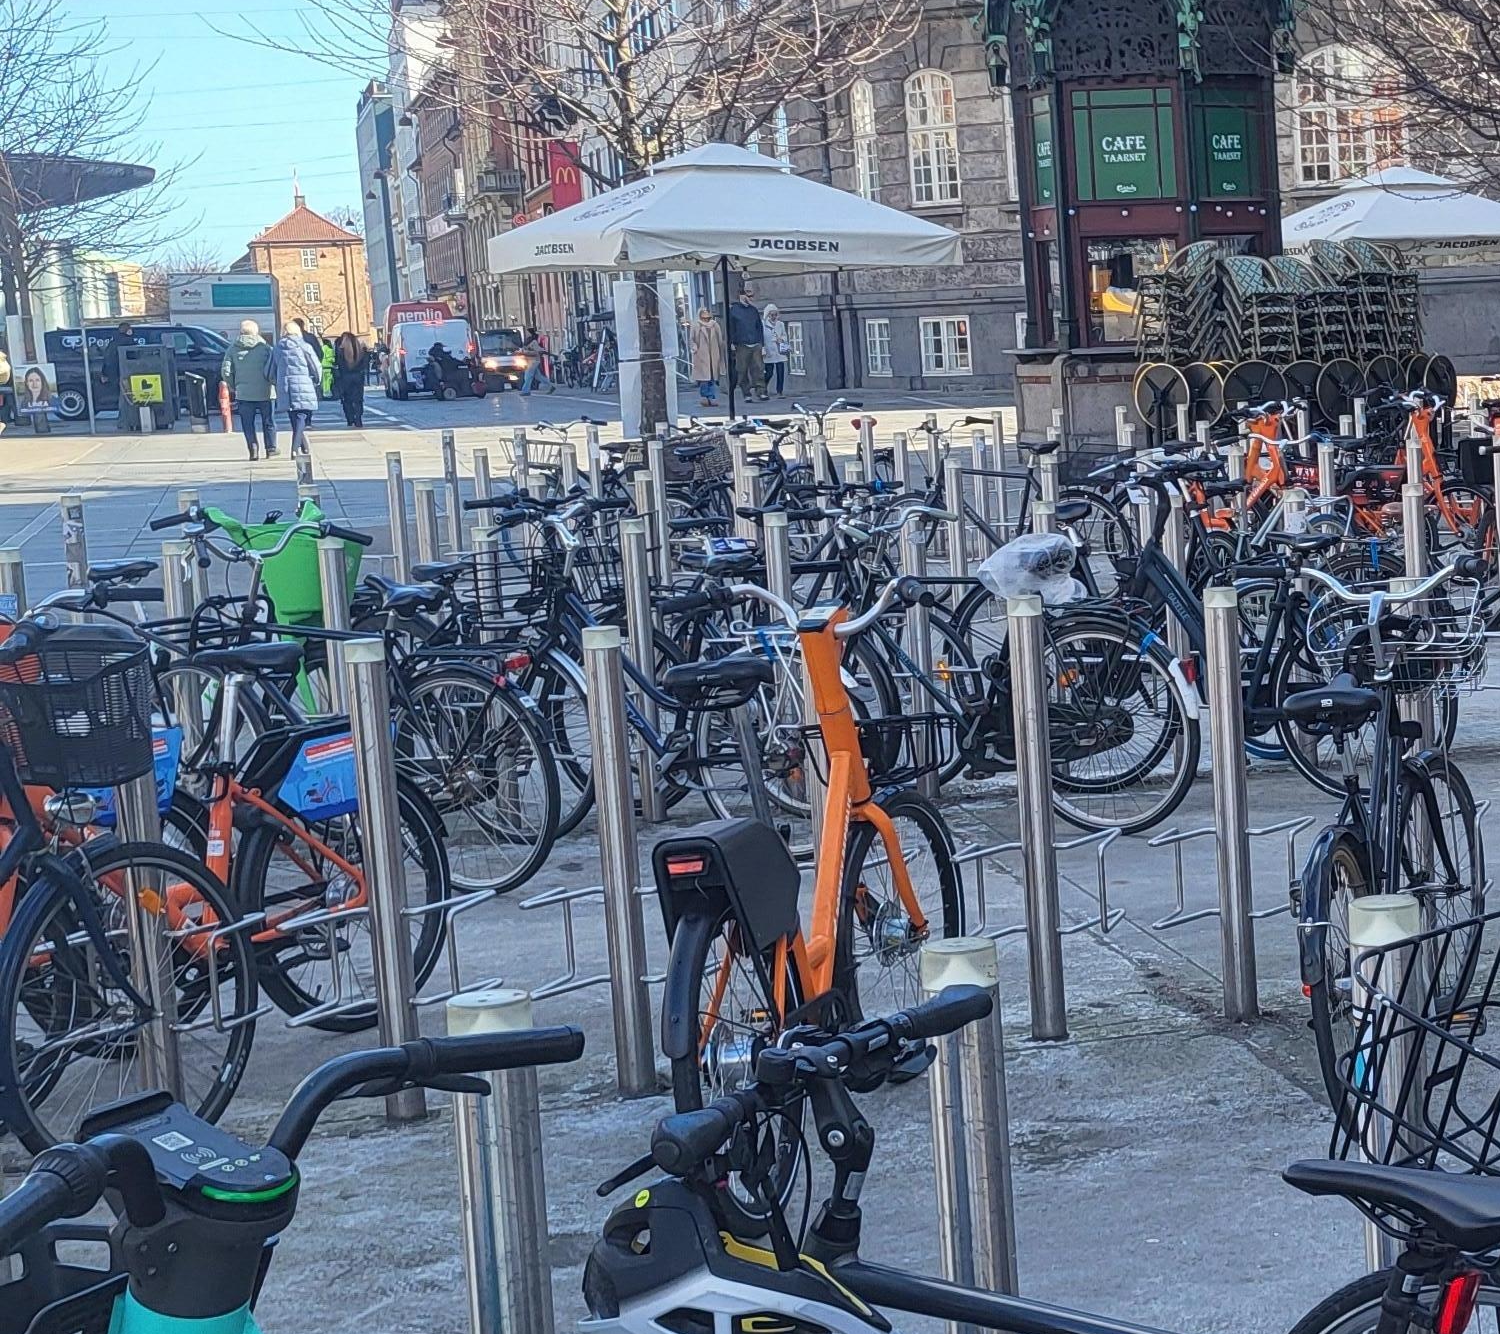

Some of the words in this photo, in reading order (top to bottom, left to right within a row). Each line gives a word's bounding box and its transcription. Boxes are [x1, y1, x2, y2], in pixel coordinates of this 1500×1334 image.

[1101, 135, 1147, 151] CAFE
[1212, 134, 1242, 149] CAFE
[1103, 153, 1146, 163] TAARNET
[534, 243, 574, 256] JACOBSEN
[749, 238, 839, 253] JACOBSEN
[1433, 239, 1500, 249] JACOBSEN
[397, 308, 443, 323] nemlig
